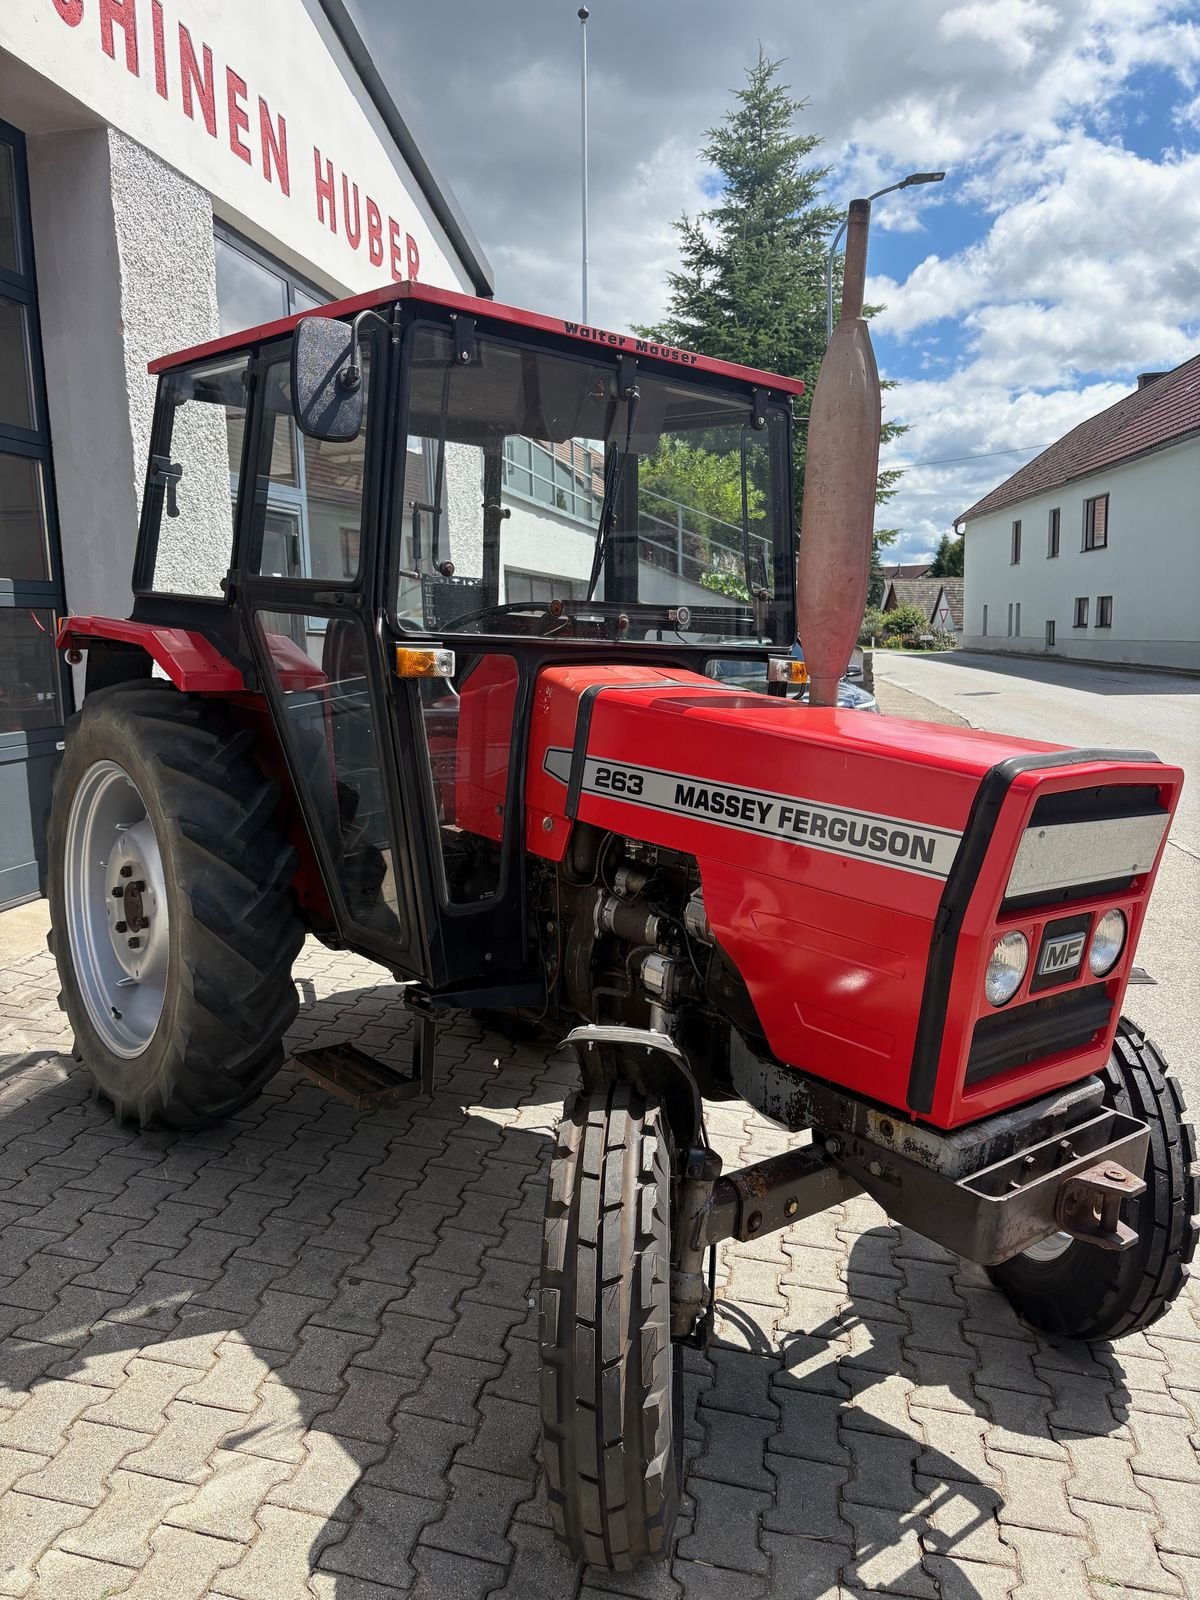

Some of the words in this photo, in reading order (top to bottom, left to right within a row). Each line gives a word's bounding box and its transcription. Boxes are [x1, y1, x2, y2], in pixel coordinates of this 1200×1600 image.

[52, 0, 290, 198] HINEN
[313, 146, 420, 282] HUBER
[564, 321, 626, 347] Walter
[635, 339, 697, 364] Mauser
[594, 767, 644, 796] 263
[674, 784, 774, 825] MASSEY
[777, 807, 936, 864] FERGUSON
[1045, 941, 1082, 969] MF
